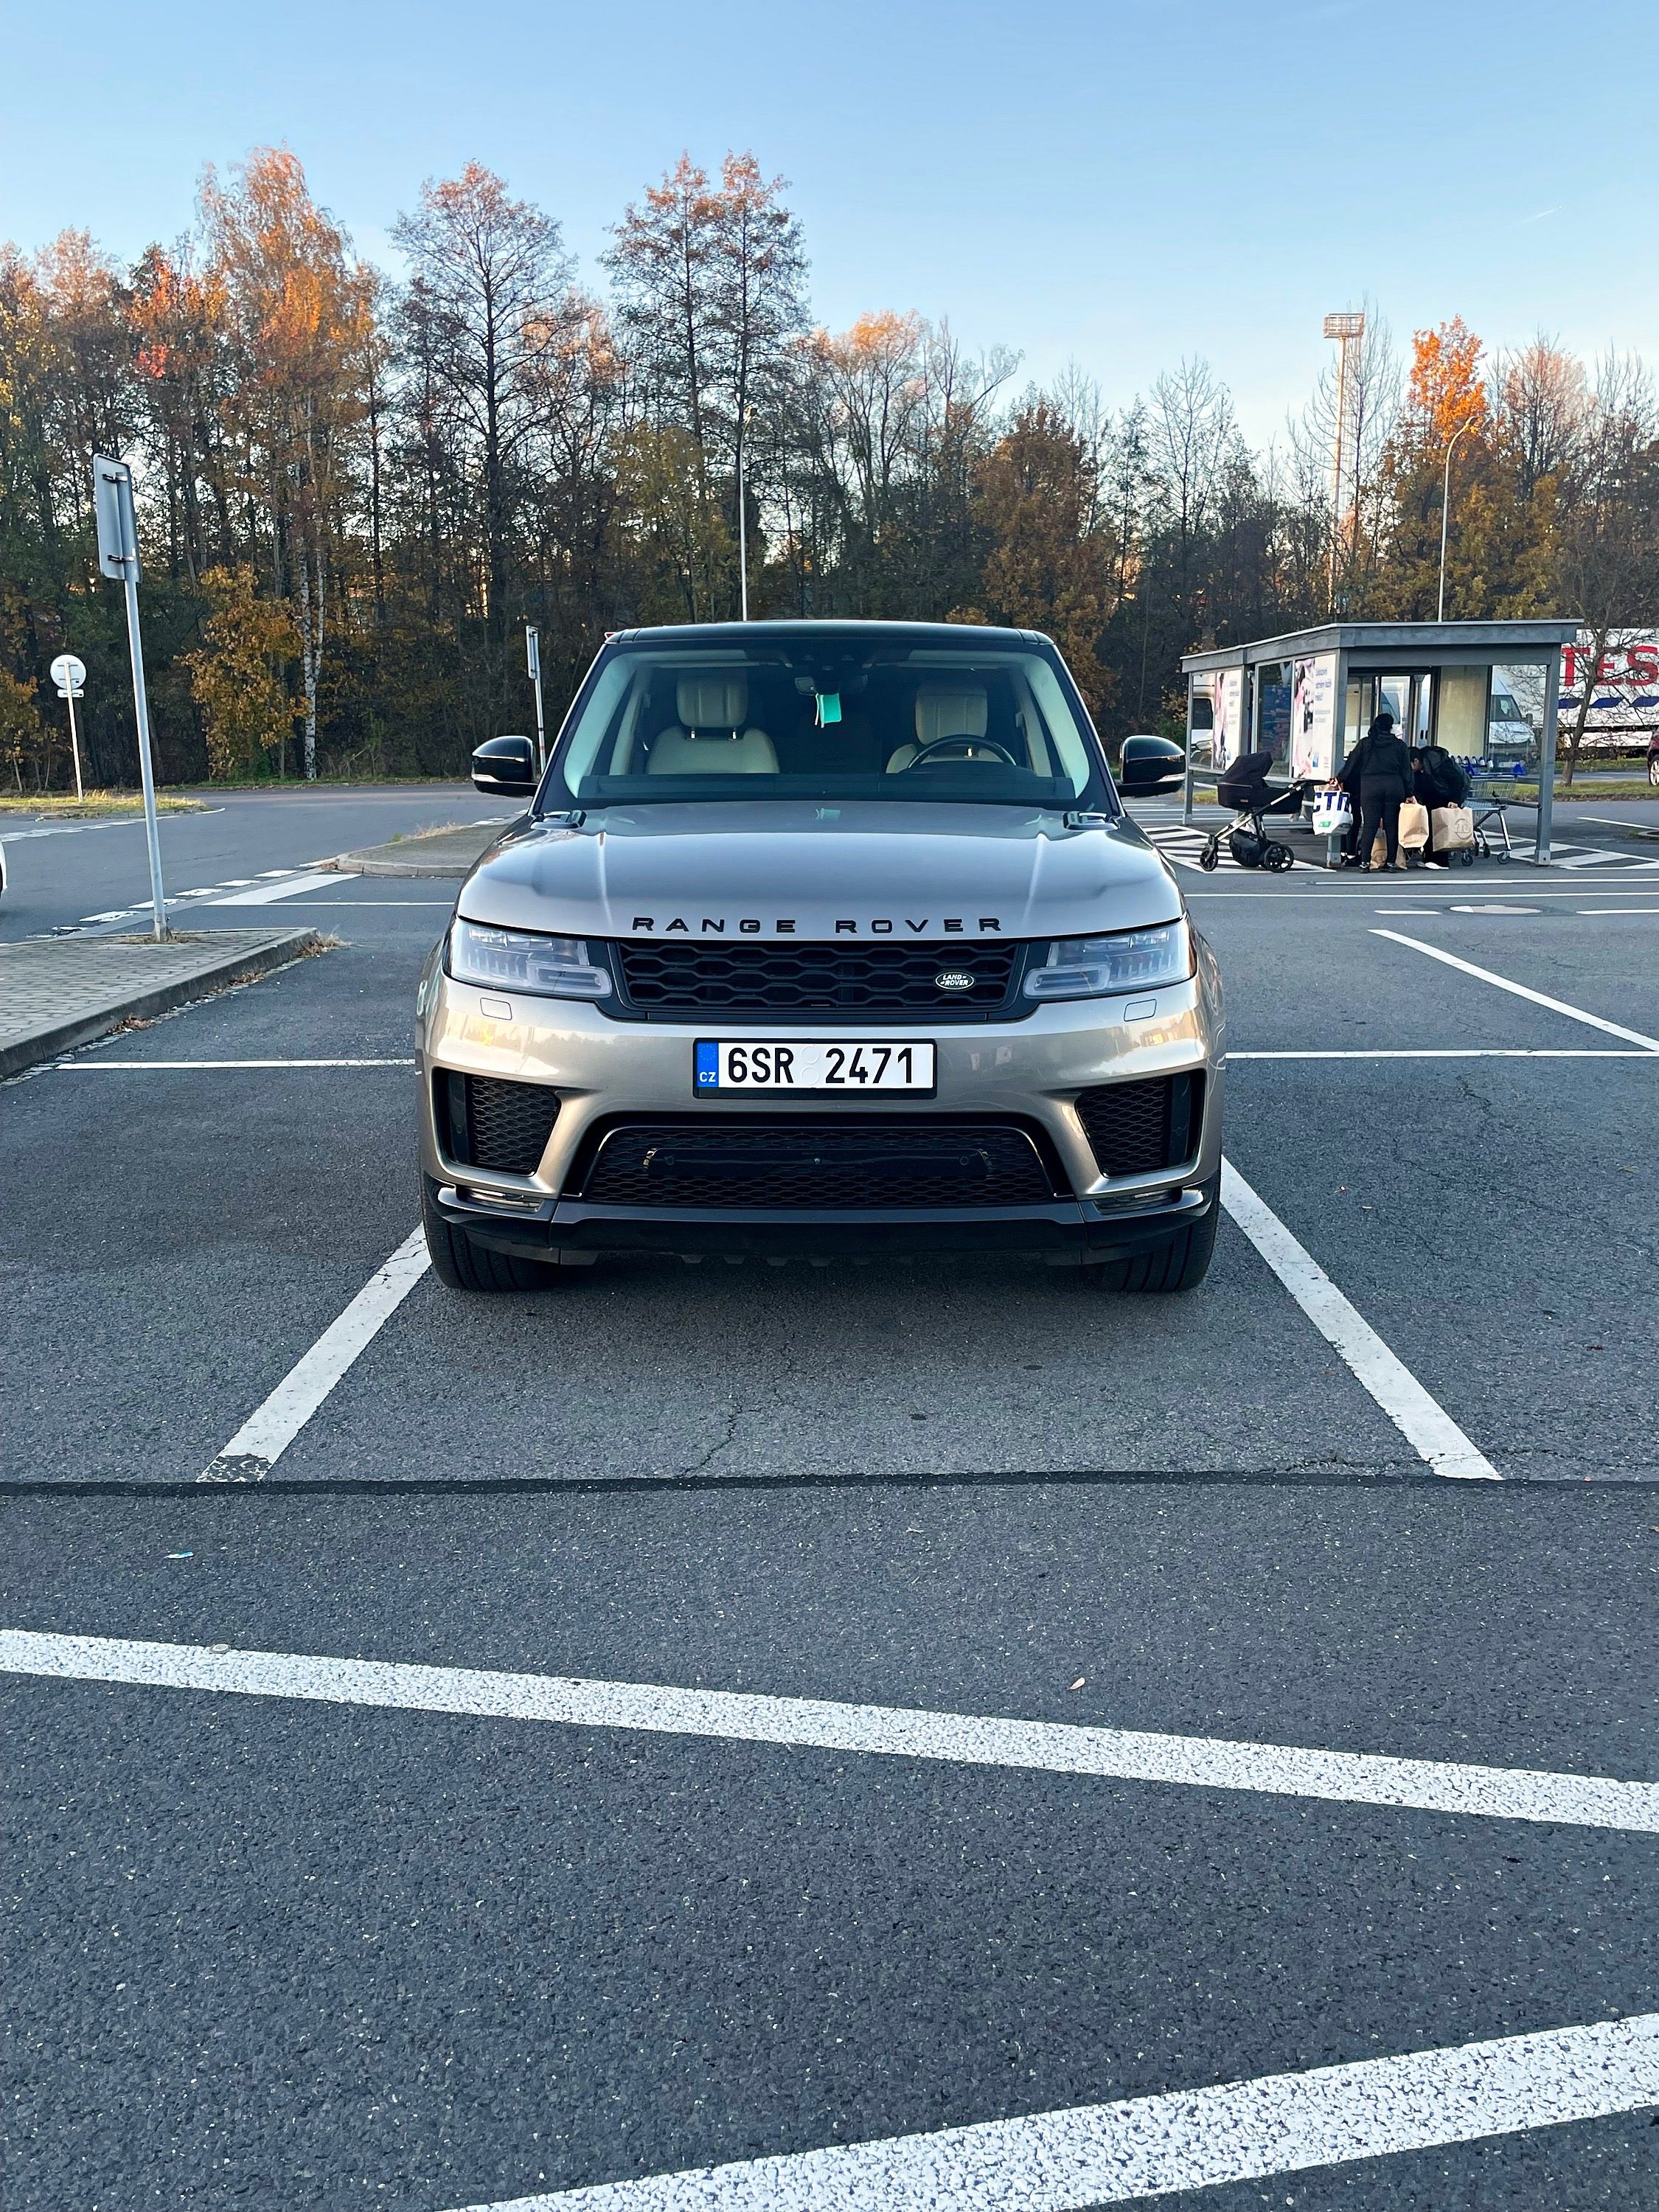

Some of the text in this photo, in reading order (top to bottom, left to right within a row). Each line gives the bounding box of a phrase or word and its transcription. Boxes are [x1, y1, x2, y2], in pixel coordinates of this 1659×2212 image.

[632, 917, 1002, 933] RANGE ROVER
[728, 1047, 913, 1084] 6SR 2471
[699, 1071, 716, 1083] CZ
